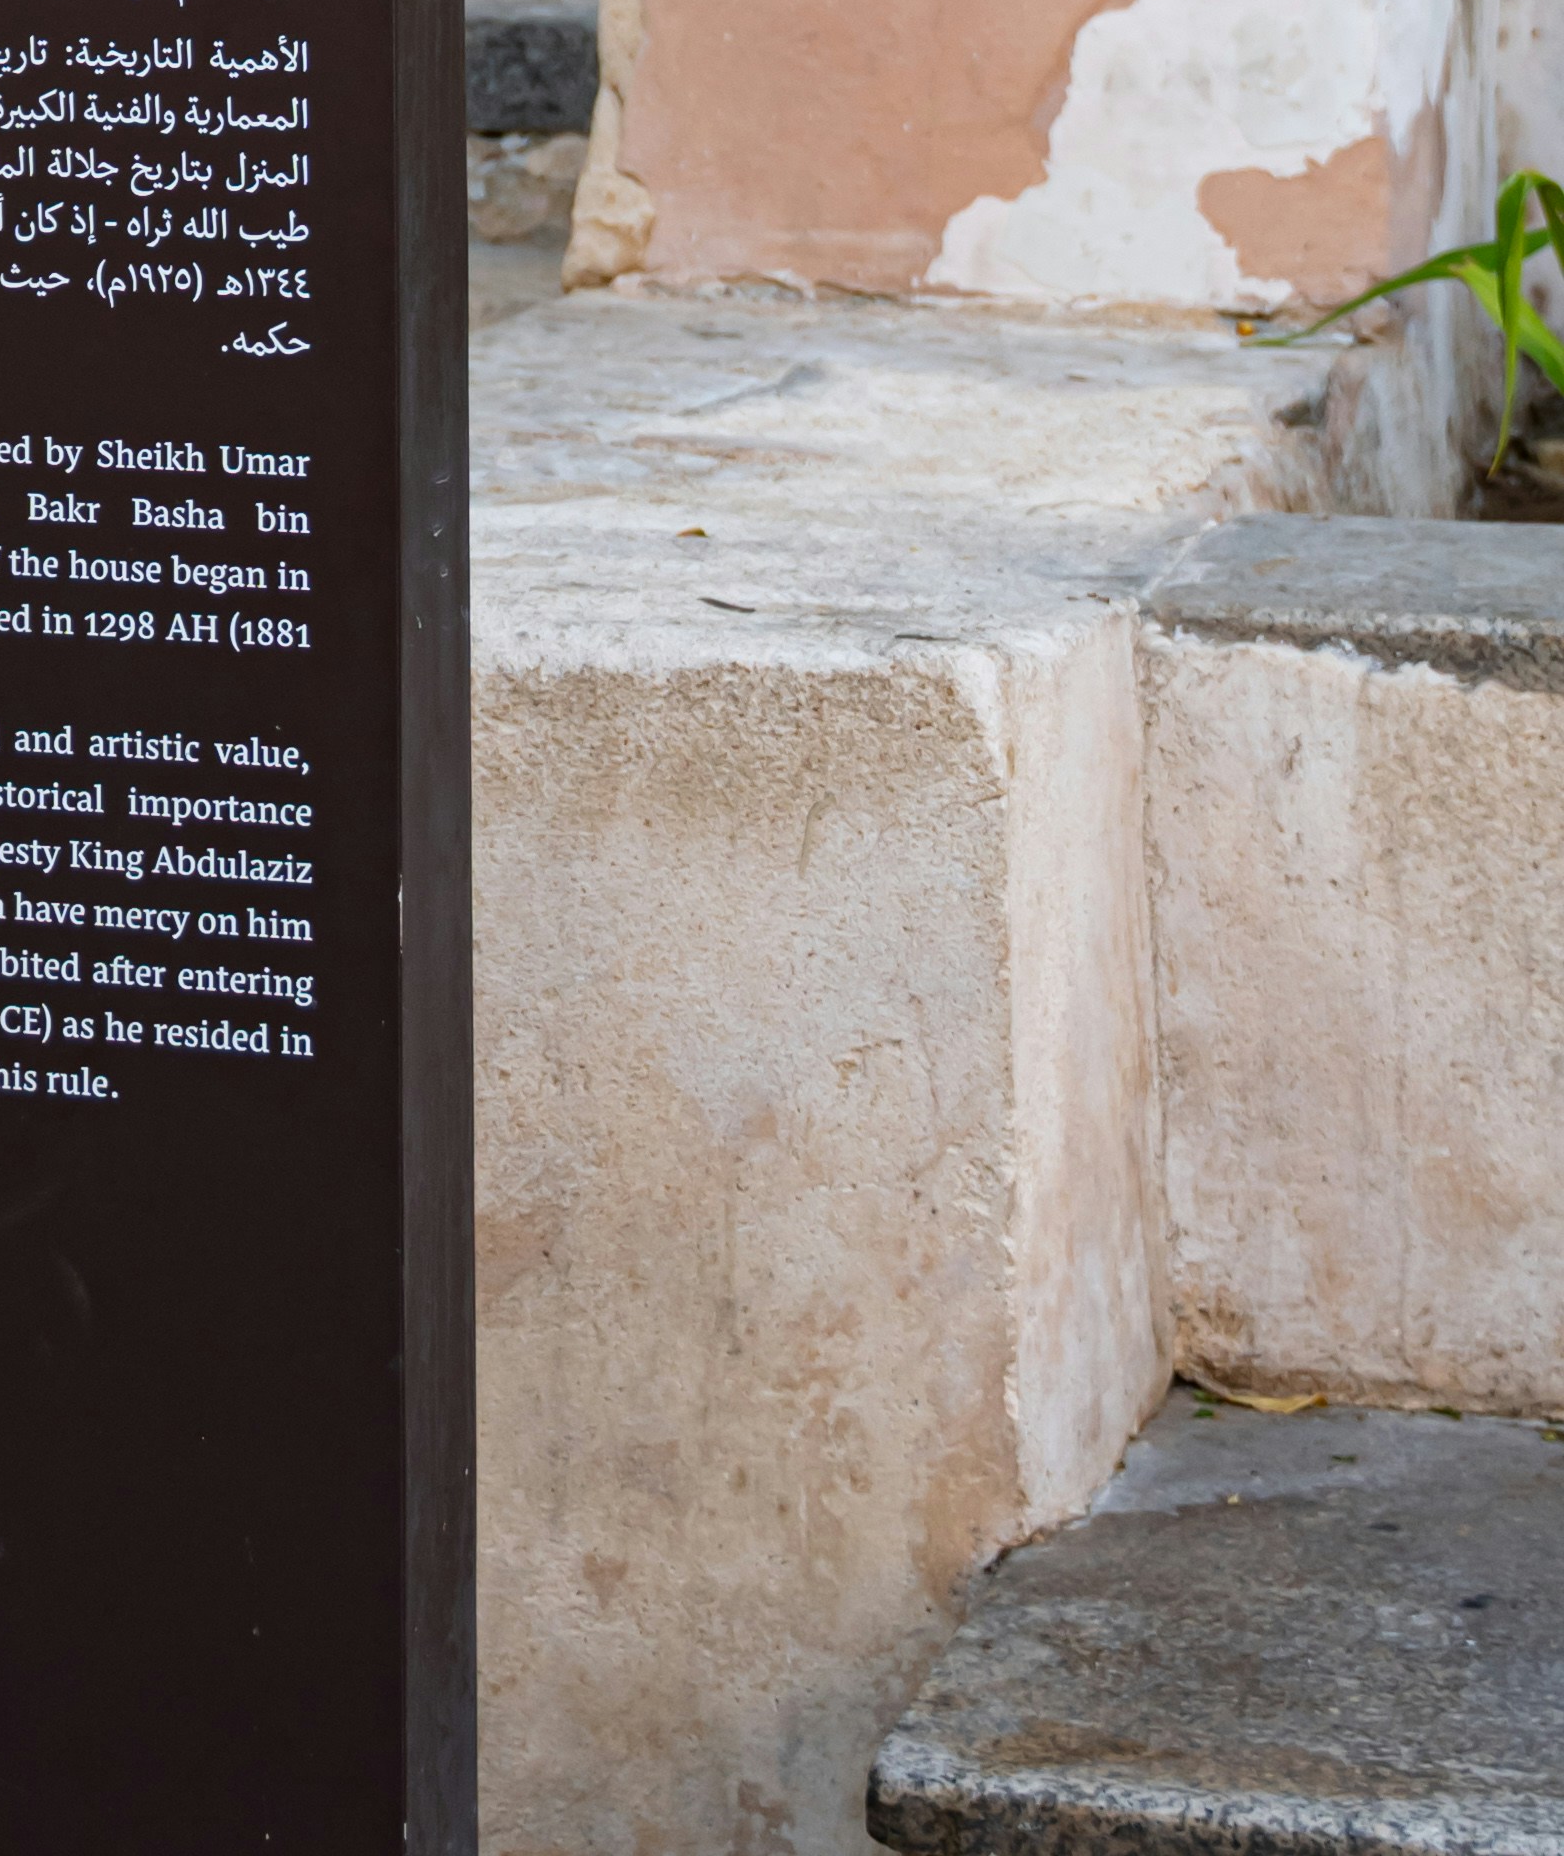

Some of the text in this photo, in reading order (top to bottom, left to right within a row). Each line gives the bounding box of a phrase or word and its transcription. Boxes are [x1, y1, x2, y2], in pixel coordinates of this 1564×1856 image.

[65, 36, 193, 79] التاريخية:
[209, 34, 308, 80] الأهمية
[83, 91, 176, 136] والفنية
[184, 94, 308, 137] المعمارية
[47, 146, 120, 187] جلالة
[130, 149, 213, 198] بتاريخ
[225, 151, 309, 195] المنزل
[14, 200, 65, 243] كان
[70, 203, 97, 246] إذ
[126, 205, 173, 249] ثراه
[182, 205, 228, 241] الله
[238, 209, 310, 251] طيب
[43, 435, 84, 475] by
[96, 438, 207, 473] Sheikh
[218, 444, 311, 478] Umar
[26, 491, 101, 525] Bakr
[131, 496, 226, 531] Basha
[254, 501, 311, 535] bin
[7, 545, 59, 580] the
[67, 548, 162, 584] house
[170, 553, 268, 596] began
[277, 560, 311, 592] in
[14, 723, 75, 757] and
[88, 729, 200, 764] artistic
[213, 735, 310, 776] value,
[127, 785, 313, 828] importance
[68, 839, 145, 882] King
[150, 844, 313, 886] Abdulaziz
[13, 890, 86, 927] have
[93, 904, 191, 941] mercy
[197, 911, 240, 937] on
[246, 906, 314, 942] him
[92, 954, 167, 989] after
[177, 965, 314, 1008] entering
[45, 1065, 119, 1099] rule.
